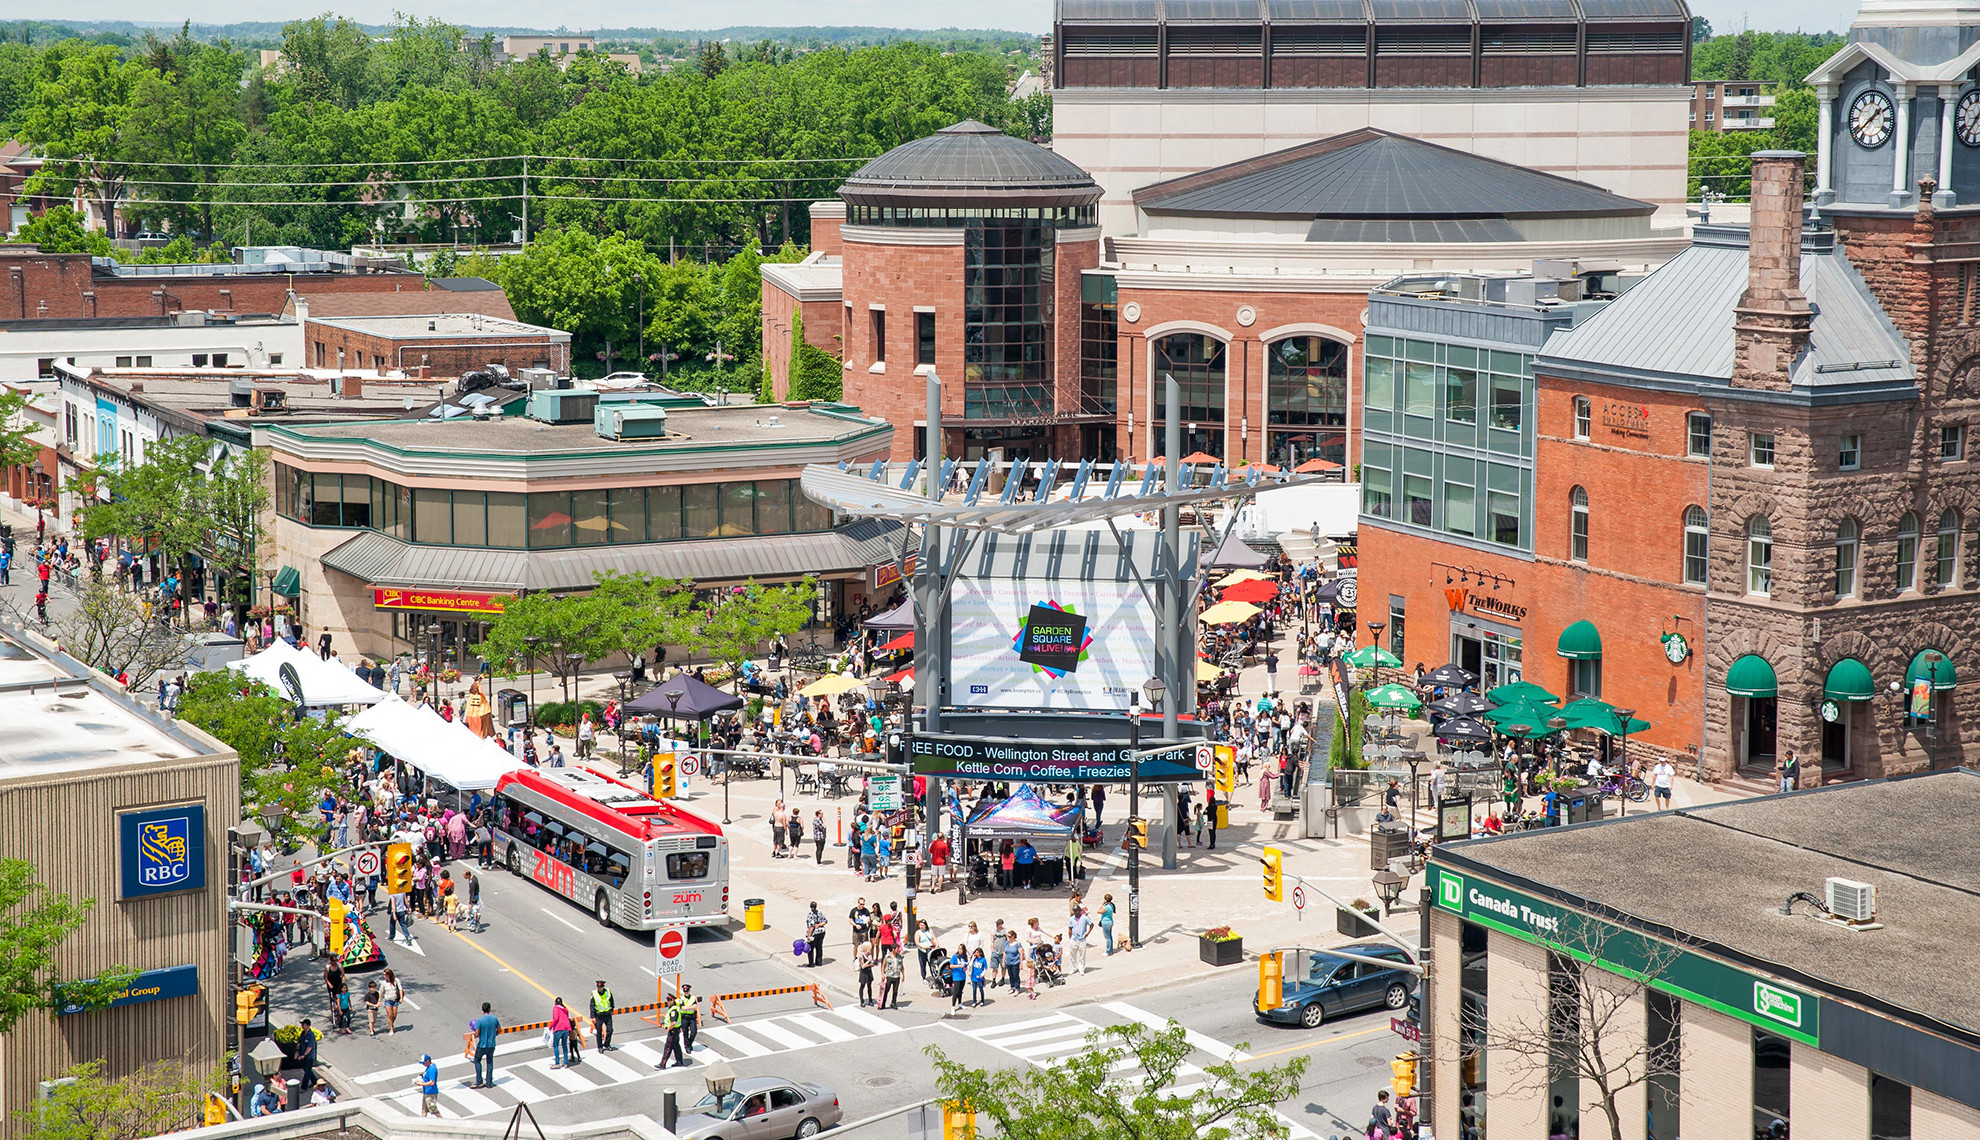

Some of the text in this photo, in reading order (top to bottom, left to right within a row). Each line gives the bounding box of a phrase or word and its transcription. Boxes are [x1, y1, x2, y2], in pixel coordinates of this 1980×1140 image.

[384, 589, 401, 598] CIBC
[410, 595, 480, 608] CIBC Banking Centre
[1032, 626, 1072, 636] GARDEN
[1032, 635, 1072, 644] SQUARE
[1041, 645, 1063, 653] LIVE!
[936, 744, 973, 758] FOOD
[984, 746, 1048, 763] Wellington
[1051, 749, 1090, 762] Street
[1094, 749, 1116, 762] and
[1119, 749, 1153, 764] Gge
[1157, 748, 1185, 761] Park
[956, 760, 1132, 779] Kettle Corn, Coffee, Freezies
[969, 827, 994, 836] Festivals
[951, 824, 961, 864] Festivals
[145, 863, 184, 882] RBC
[1442, 877, 1460, 904] TD
[1469, 887, 1559, 933] Canada Trust
[658, 964, 683, 974] CLOSED
[662, 959, 680, 967] ROAD
[131, 986, 161, 998] Group
